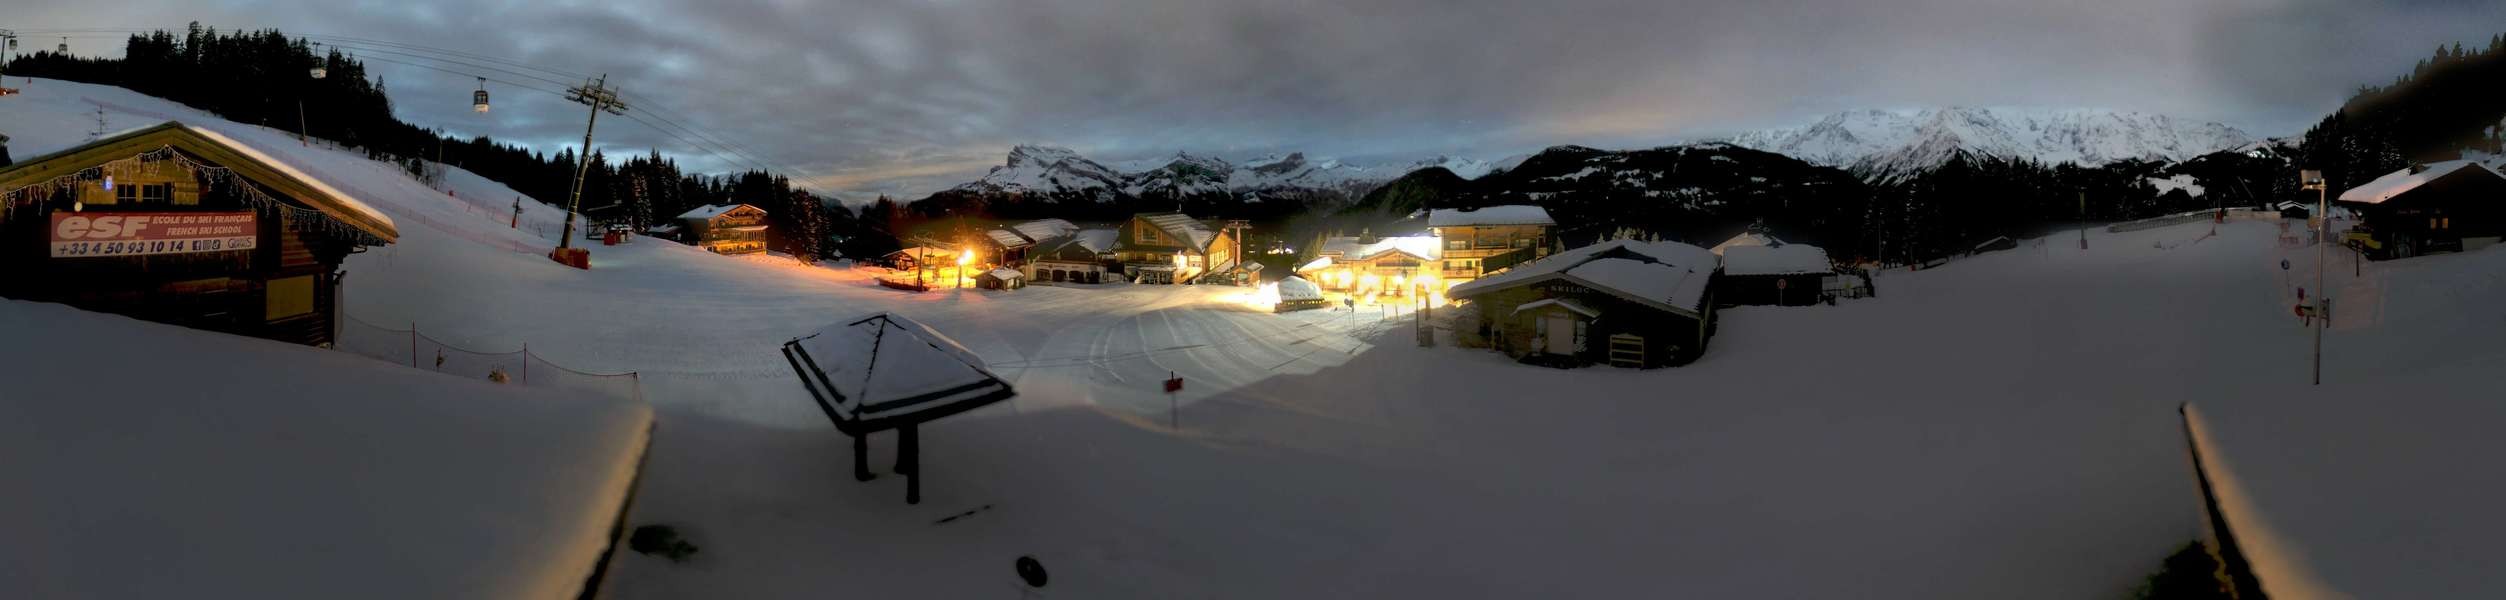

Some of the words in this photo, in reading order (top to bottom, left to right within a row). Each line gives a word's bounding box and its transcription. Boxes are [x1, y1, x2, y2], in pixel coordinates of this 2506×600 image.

[183, 216, 196, 224] DU
[197, 215, 212, 224] SKI
[166, 227, 198, 236] FRENCH
[199, 226, 212, 235] SKI
[213, 225, 242, 235] SCHOOL
[59, 242, 89, 255] +33
[92, 242, 102, 254] 4
[104, 242, 124, 254] 50
[128, 241, 144, 253] 93
[150, 241, 165, 253] 10
[170, 240, 184, 251] 14
